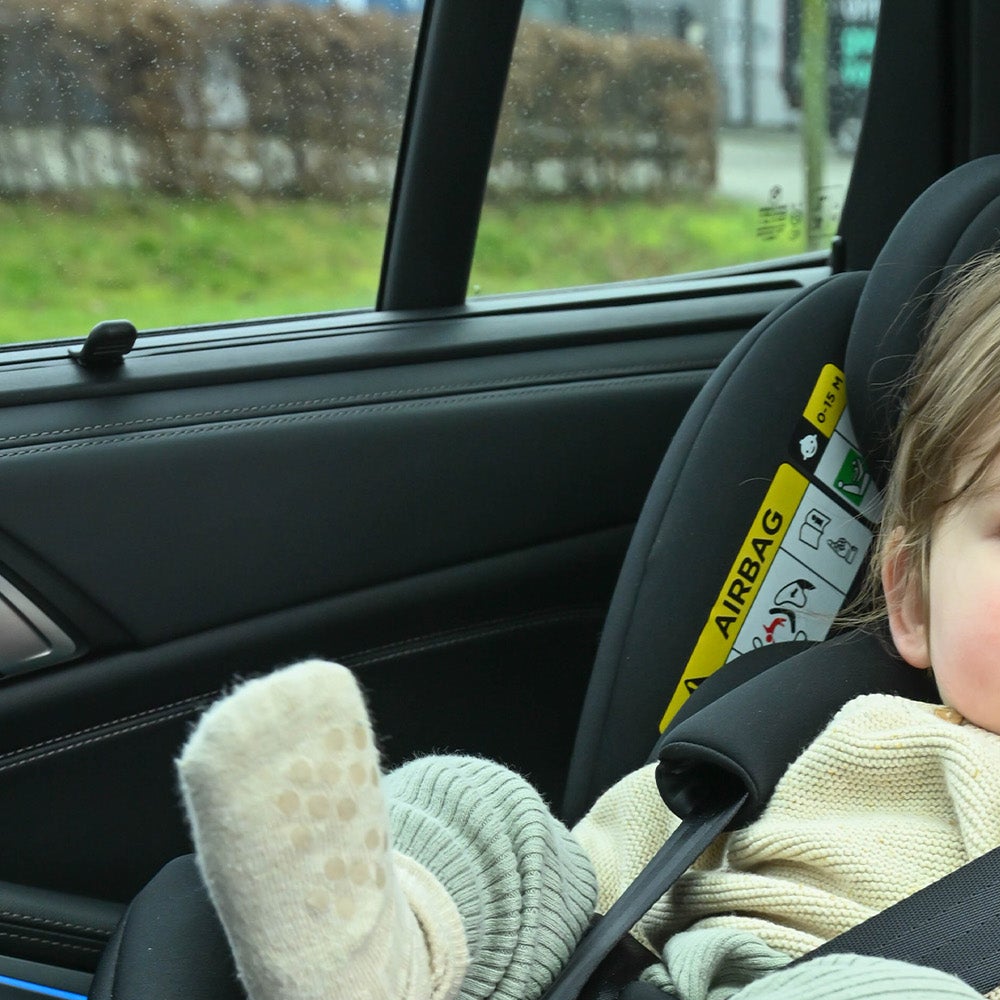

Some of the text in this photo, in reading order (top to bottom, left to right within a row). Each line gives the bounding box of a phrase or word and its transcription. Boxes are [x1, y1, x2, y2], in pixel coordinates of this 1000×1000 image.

[817, 376, 844, 423] 0-15 M
[715, 508, 783, 640] AIRBAG
